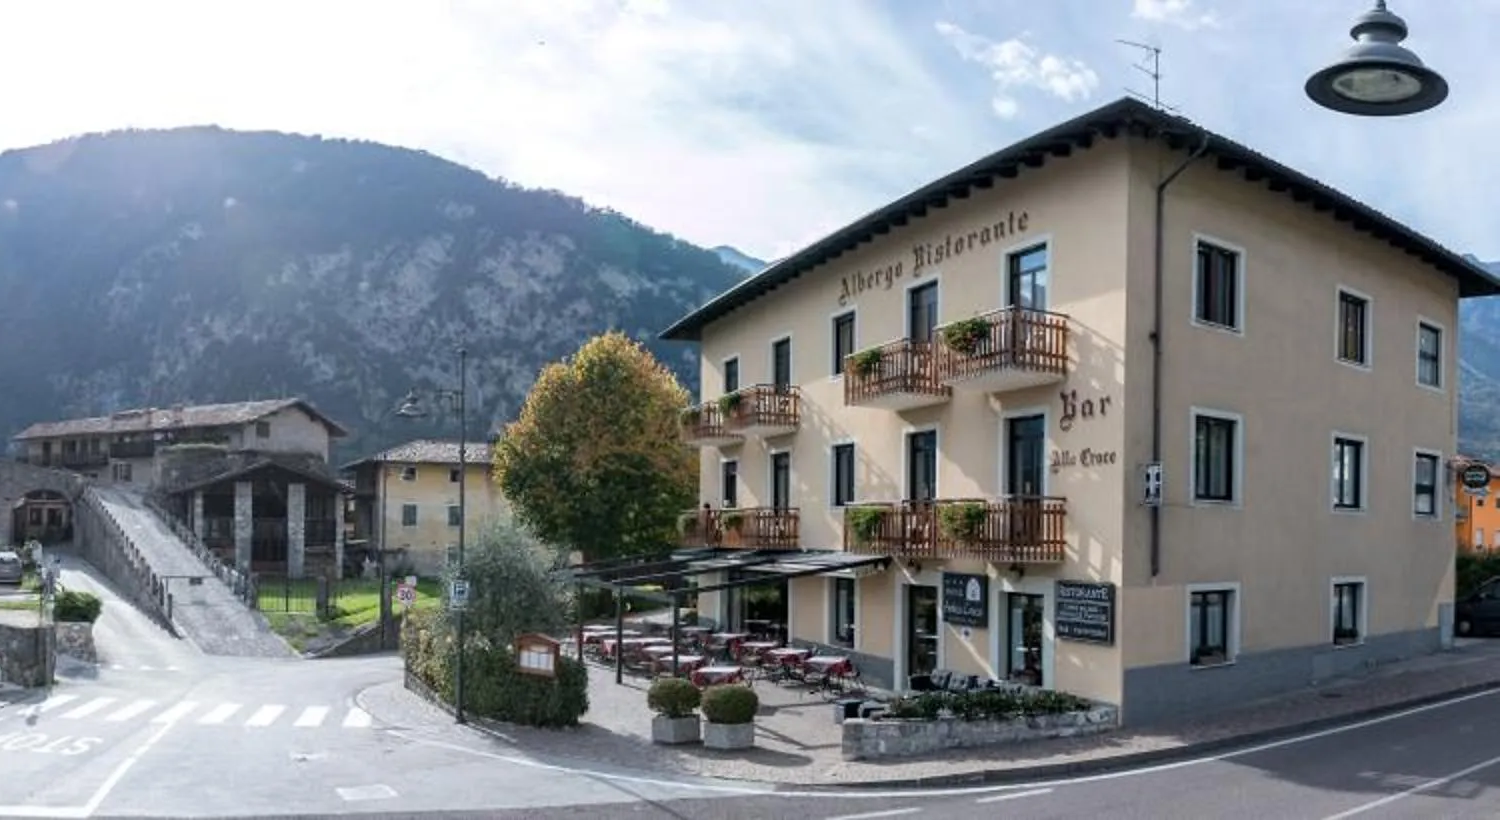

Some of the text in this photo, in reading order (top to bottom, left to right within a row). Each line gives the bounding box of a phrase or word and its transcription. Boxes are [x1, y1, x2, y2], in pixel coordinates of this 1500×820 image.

[838, 210, 1029, 306] Albergo Ristorante
[1059, 389, 1111, 433] Bar
[1051, 447, 1117, 475] Alla Croce
